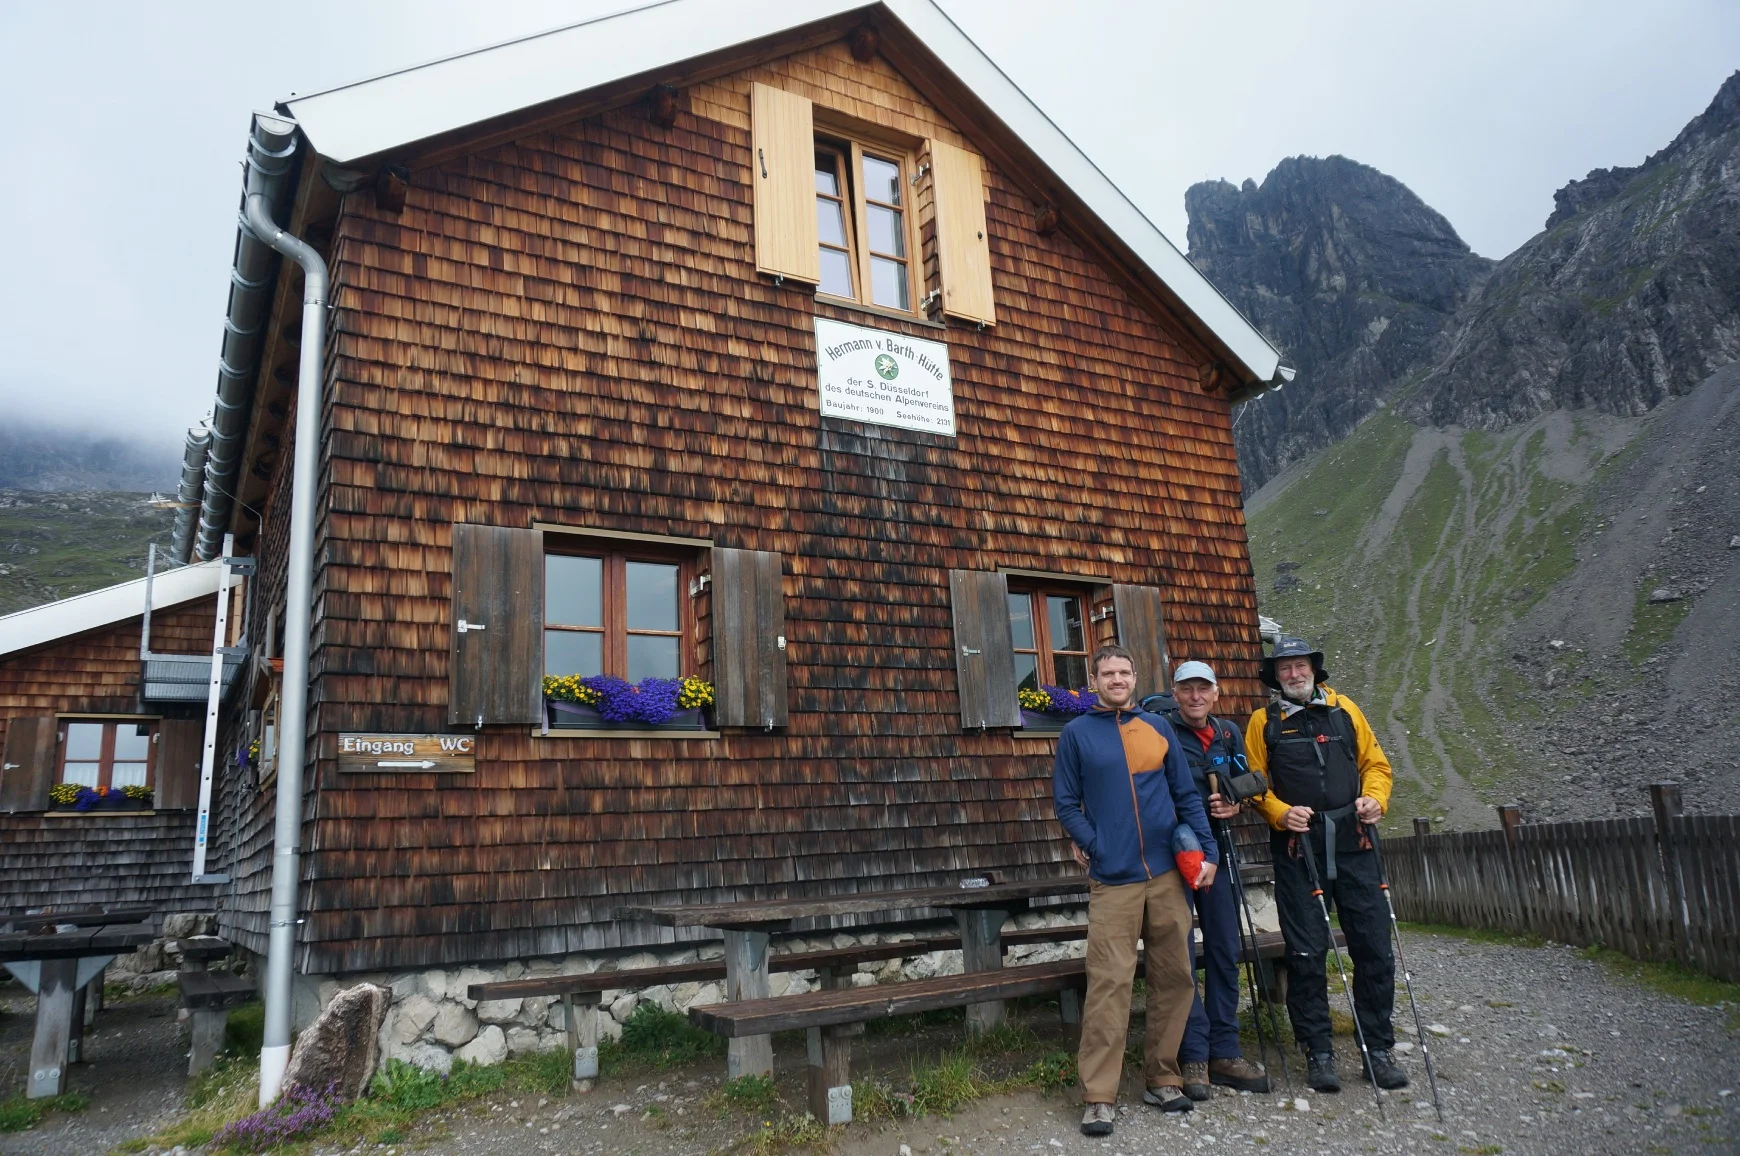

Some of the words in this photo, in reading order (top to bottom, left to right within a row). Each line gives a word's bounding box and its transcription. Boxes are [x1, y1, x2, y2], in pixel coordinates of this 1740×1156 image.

[825, 339, 873, 361] Hermann
[875, 339, 884, 351] v.
[825, 383, 842, 393] des
[845, 387, 892, 402] deutschen
[895, 395, 949, 412] Alpenvereins
[847, 377, 862, 386] der
[867, 380, 877, 389] S.
[880, 382, 929, 398] Düsseldorf
[826, 400, 863, 412] Baujahr:
[866, 406, 884, 415] 1900
[896, 410, 934, 423] Seehöhe:
[936, 417, 951, 427] 2131
[343, 737, 414, 755] Eingang
[440, 737, 470, 752] WC
